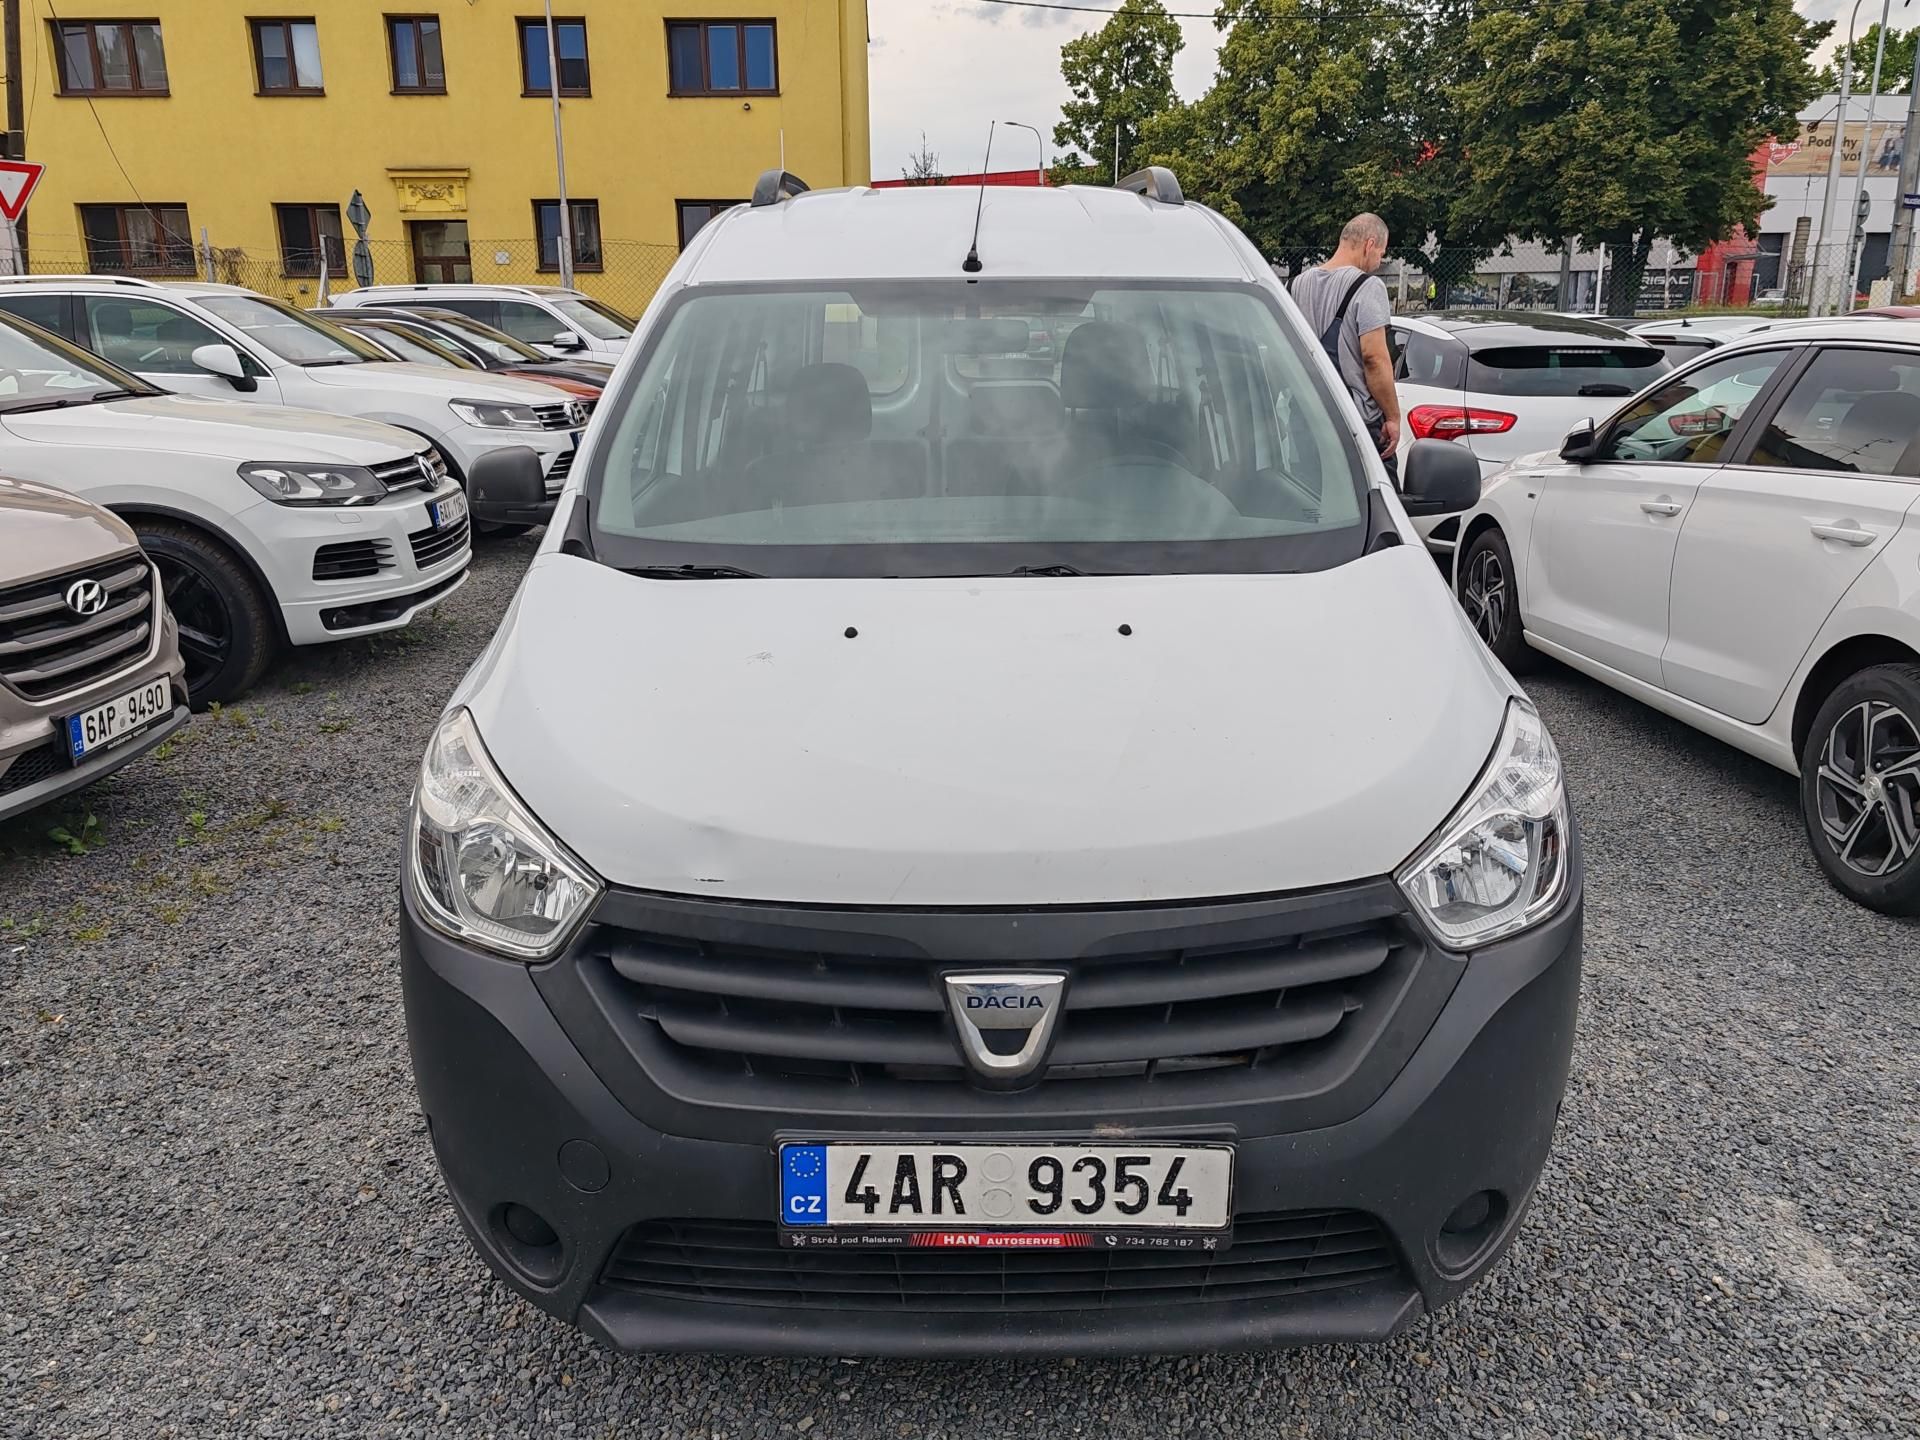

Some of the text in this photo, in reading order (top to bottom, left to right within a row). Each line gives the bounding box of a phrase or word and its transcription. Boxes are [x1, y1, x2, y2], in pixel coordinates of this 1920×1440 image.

[74, 740, 83, 752] CZ
[85, 705, 116, 744] 6AP
[128, 684, 164, 724] 9490
[966, 995, 1044, 1009] DACIA
[790, 1153, 1194, 1217] CZ 4AR 9354
[841, 1236, 859, 1246] pod
[861, 1236, 903, 1244] Ralskem
[943, 1235, 980, 1246] HAN
[986, 1236, 1061, 1246] AUTOSERVIS
[1125, 1237, 1145, 1246] 734
[1149, 1237, 1170, 1246] 762
[1174, 1238, 1194, 1247] 187
